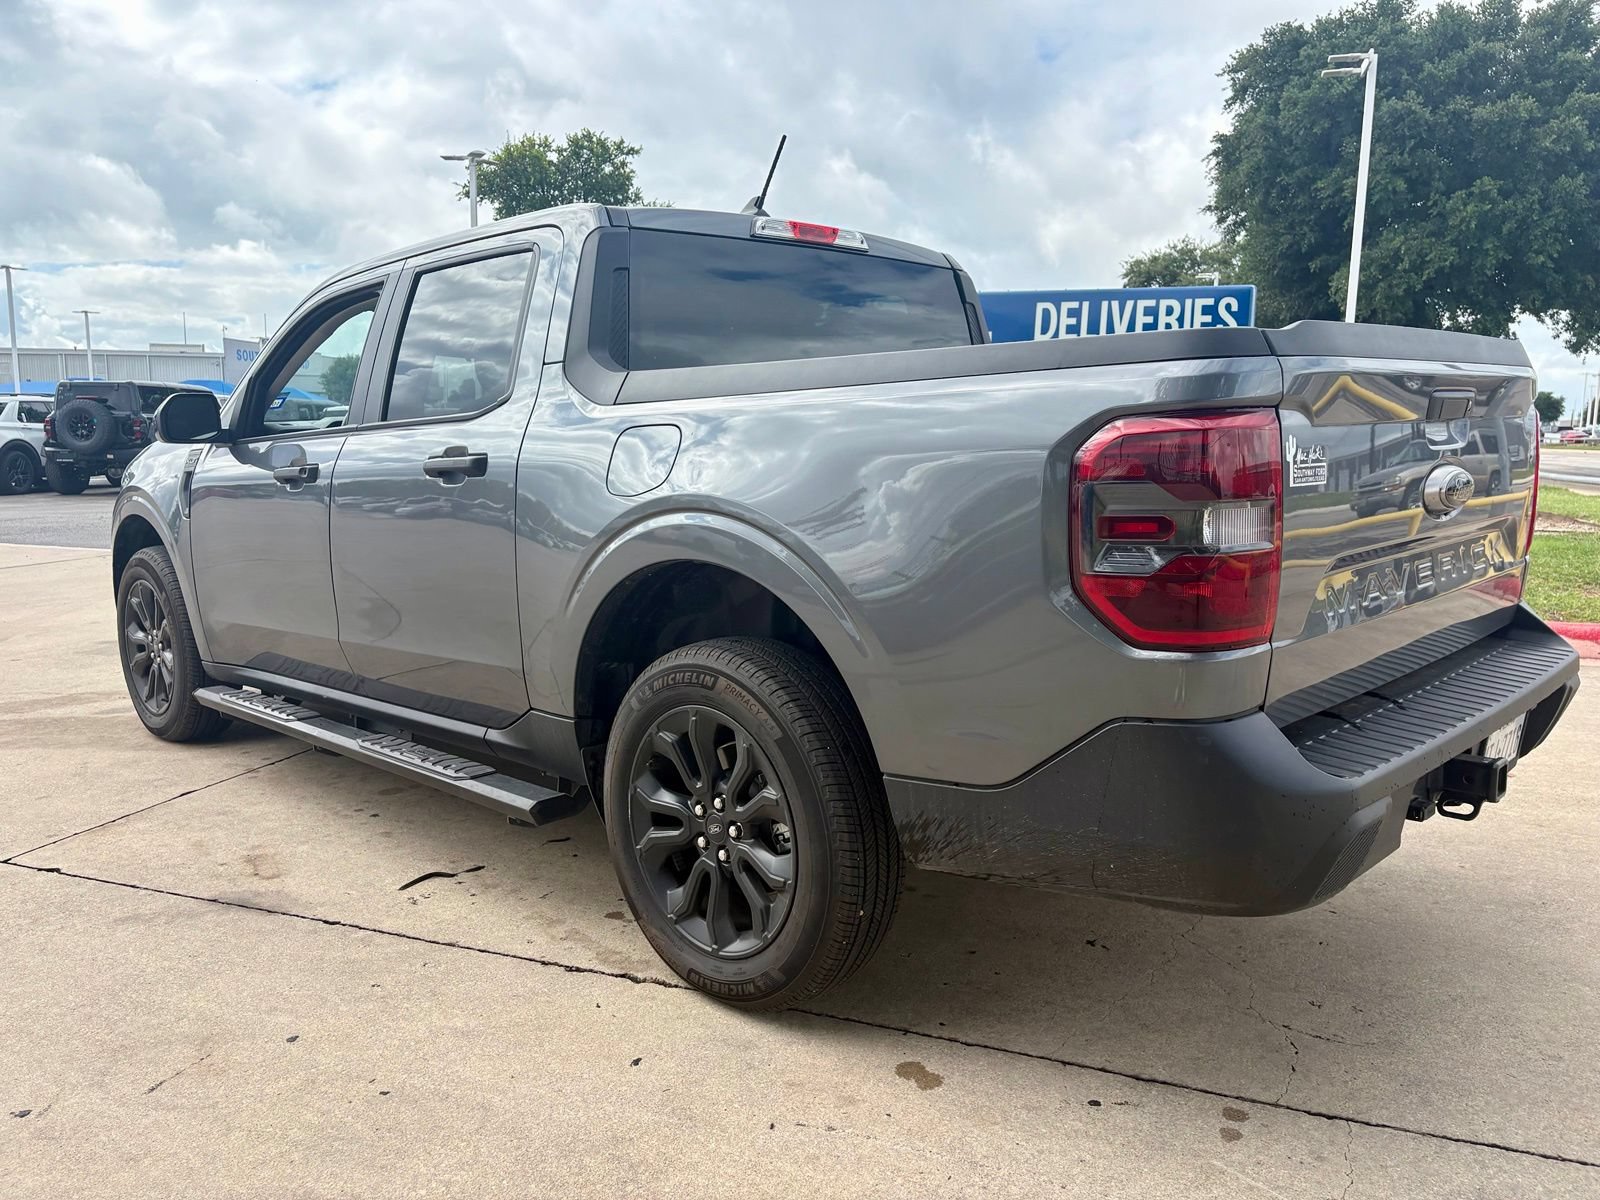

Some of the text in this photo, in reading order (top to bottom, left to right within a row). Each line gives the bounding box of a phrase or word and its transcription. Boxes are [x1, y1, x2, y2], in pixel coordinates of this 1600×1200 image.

[1034, 297, 1239, 341] DELIVERIES
[1325, 534, 1505, 616] MAVERICK
[653, 672, 714, 691] MICHELIN
[724, 683, 763, 716] PRIMACY
[689, 972, 755, 995] MICHELIN
